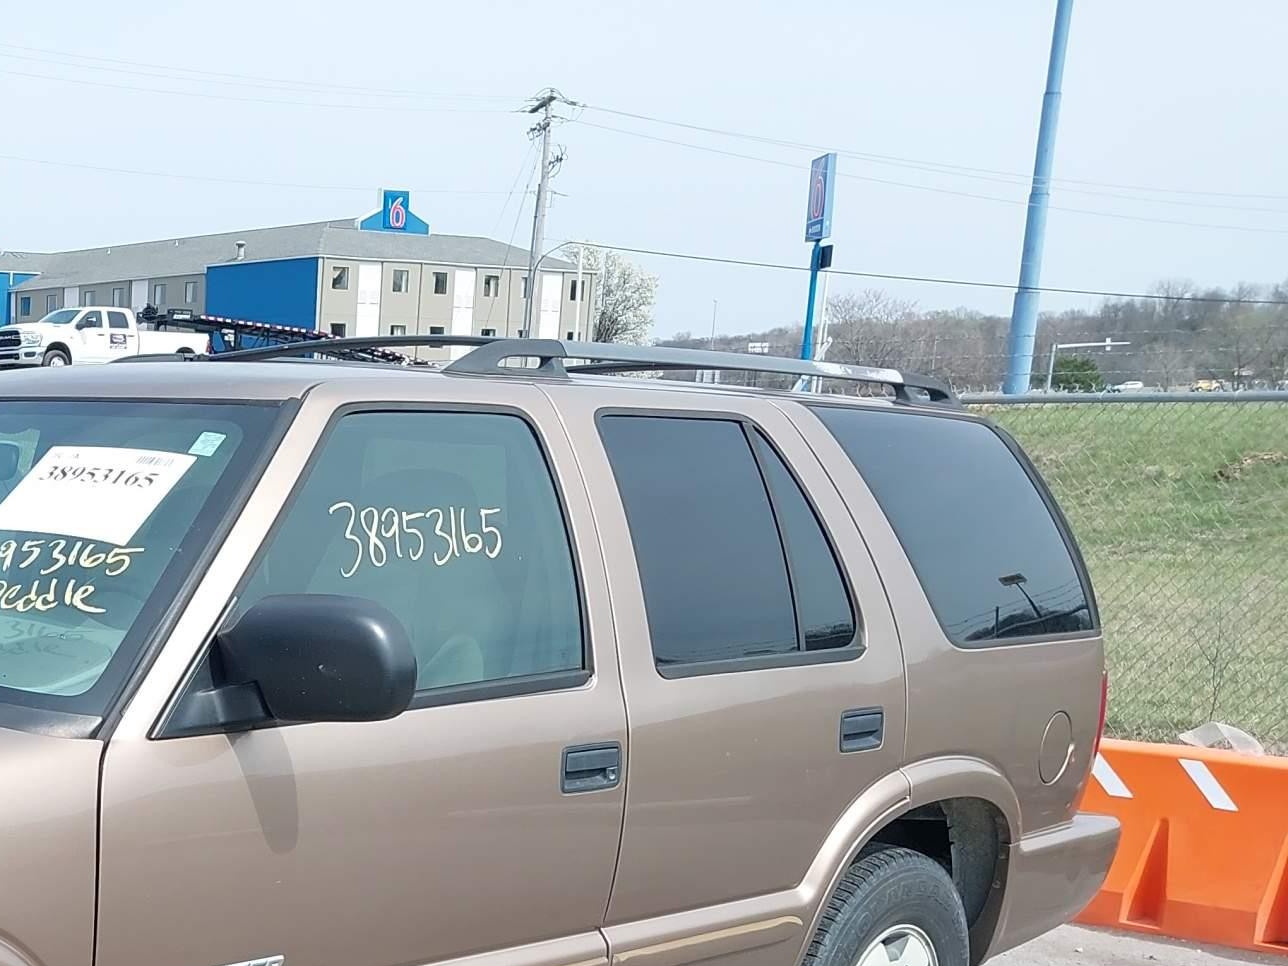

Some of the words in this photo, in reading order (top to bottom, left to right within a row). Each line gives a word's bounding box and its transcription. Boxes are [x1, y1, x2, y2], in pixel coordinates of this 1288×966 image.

[390, 197, 406, 228] 6
[39, 465, 160, 488] 38953165
[329, 501, 502, 577] 38953165
